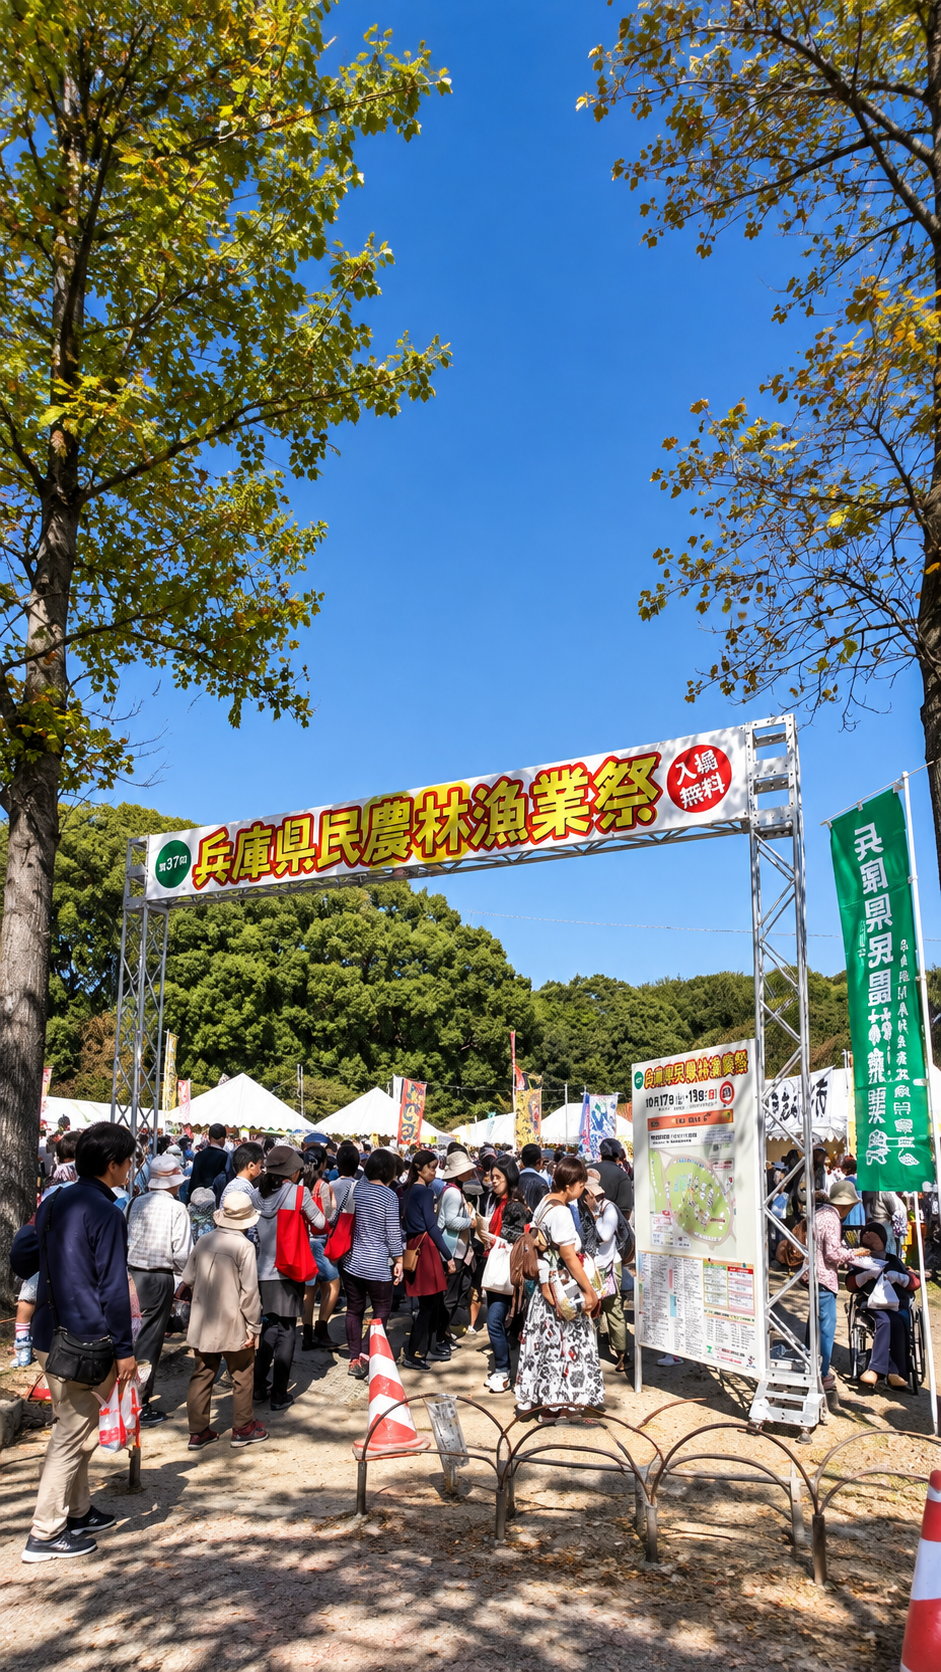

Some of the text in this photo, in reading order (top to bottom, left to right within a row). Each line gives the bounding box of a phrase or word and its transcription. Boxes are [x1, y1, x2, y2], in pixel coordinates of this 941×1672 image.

[192, 751, 662, 890] 兵庫県民農林漁業祭
[679, 771, 726, 809] 無料
